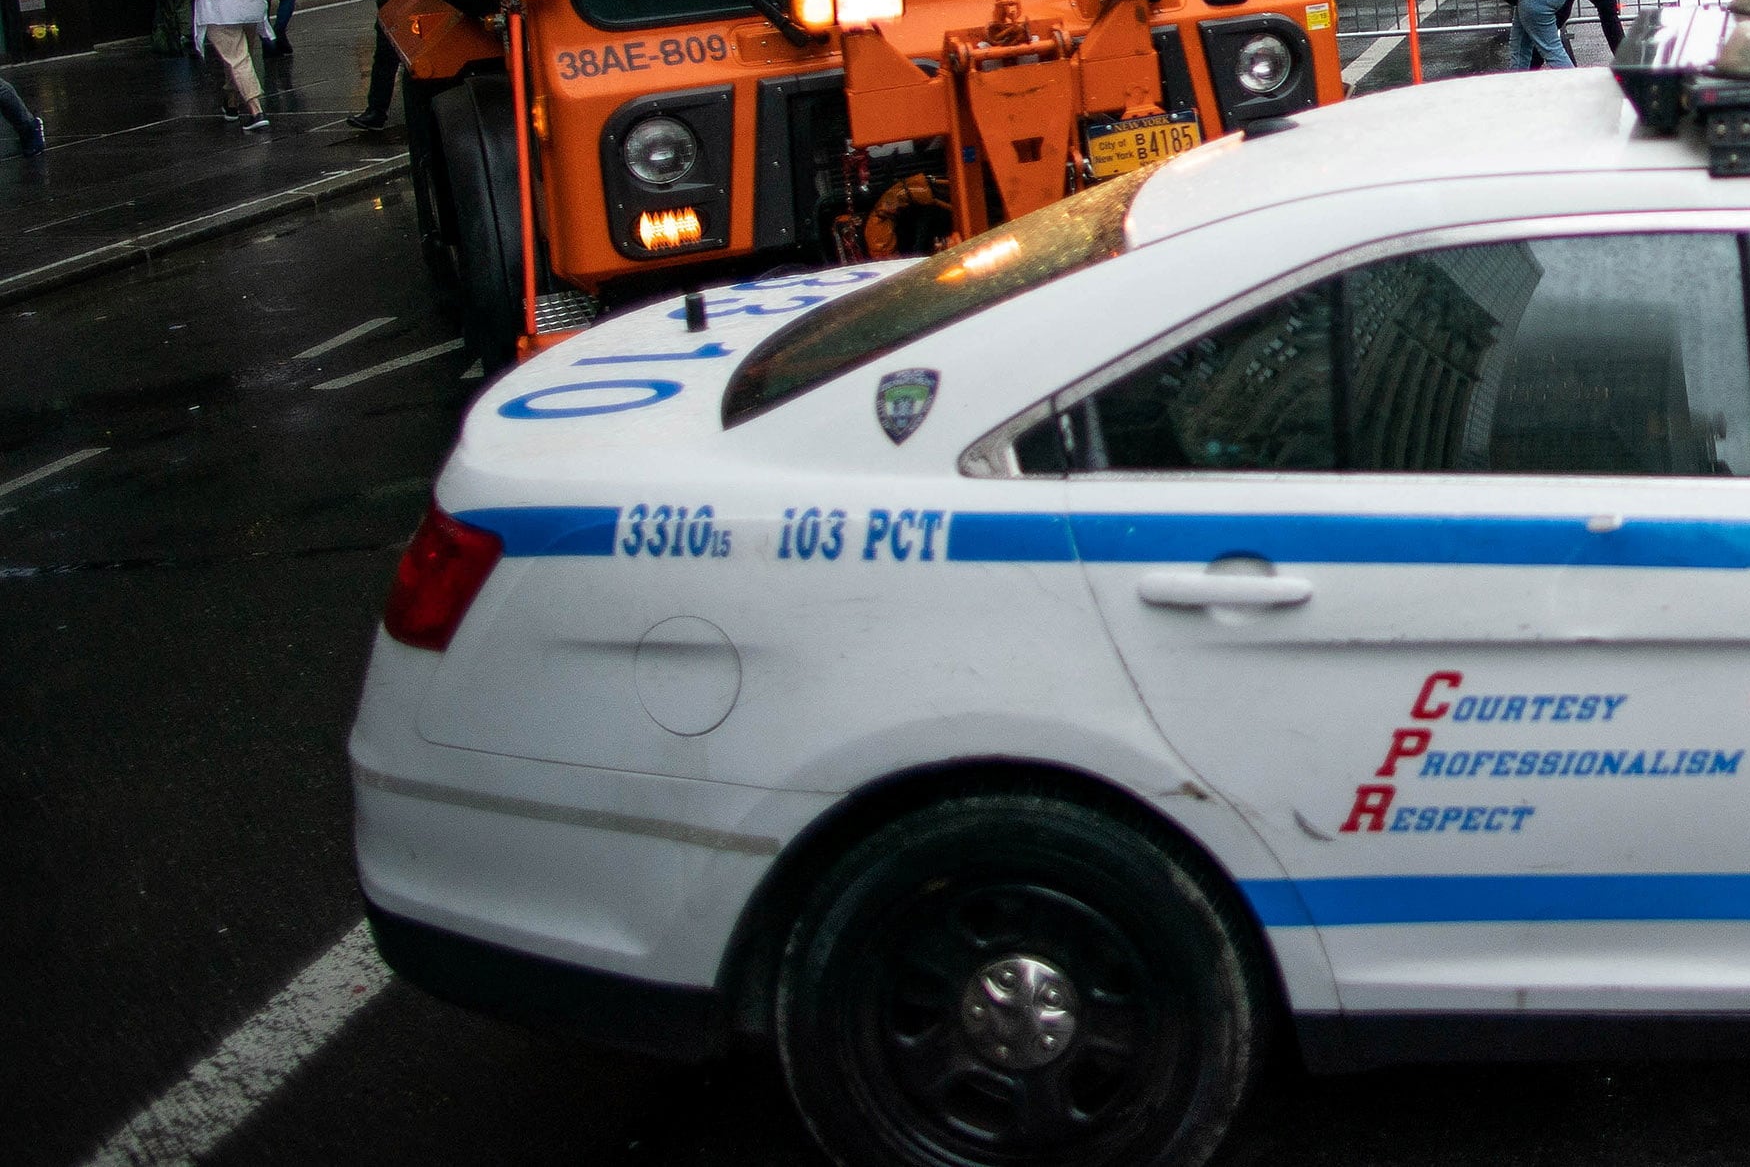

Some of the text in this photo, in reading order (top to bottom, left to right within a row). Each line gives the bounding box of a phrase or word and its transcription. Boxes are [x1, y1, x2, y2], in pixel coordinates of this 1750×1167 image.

[558, 34, 727, 80] 38AE-809
[1114, 115, 1171, 132] NEW YORK
[1098, 138, 1126, 151] City of
[1150, 125, 1193, 156] 4185
[1095, 152, 1134, 164] New York
[622, 503, 715, 558] 3310
[777, 506, 848, 561] 103
[862, 508, 946, 562] PCT
